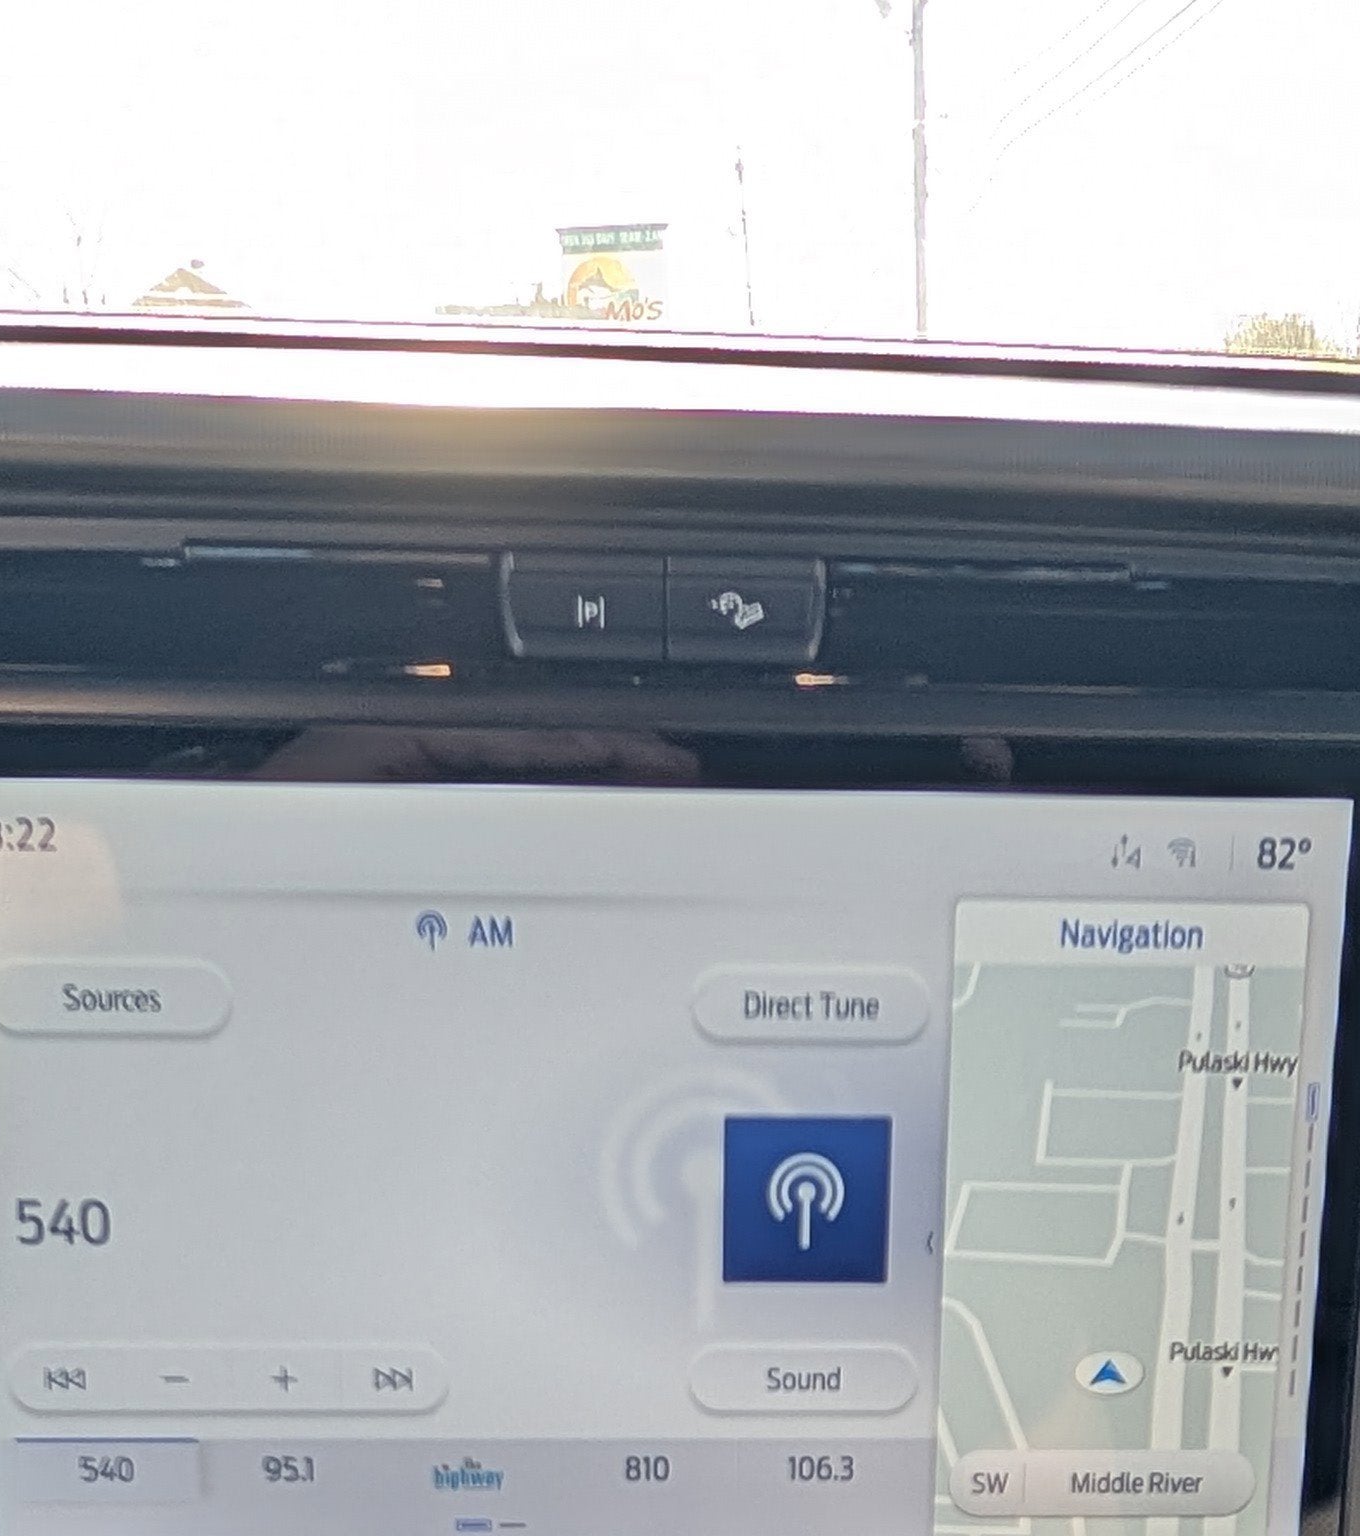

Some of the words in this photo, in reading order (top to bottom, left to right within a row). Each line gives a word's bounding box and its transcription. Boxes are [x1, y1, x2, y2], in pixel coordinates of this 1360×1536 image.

[468, 916, 514, 949] AM
[1059, 917, 1204, 955] Navigation
[61, 983, 163, 1014] Sources
[743, 991, 813, 1021] Direct
[821, 991, 881, 1021] Tune
[1178, 1049, 1249, 1074] Pulaski
[1253, 1050, 1299, 1079] Hwy
[15, 1198, 112, 1246] 540
[1169, 1341, 1239, 1363] Pulaski
[765, 1366, 842, 1392] Sound
[78, 1457, 136, 1484] 540
[261, 1457, 316, 1483] 95.1
[624, 1456, 671, 1482] 810
[787, 1456, 855, 1482] 106.3
[970, 1472, 1010, 1495] SW
[1070, 1471, 1143, 1495] Middle
[1149, 1471, 1204, 1495] River
